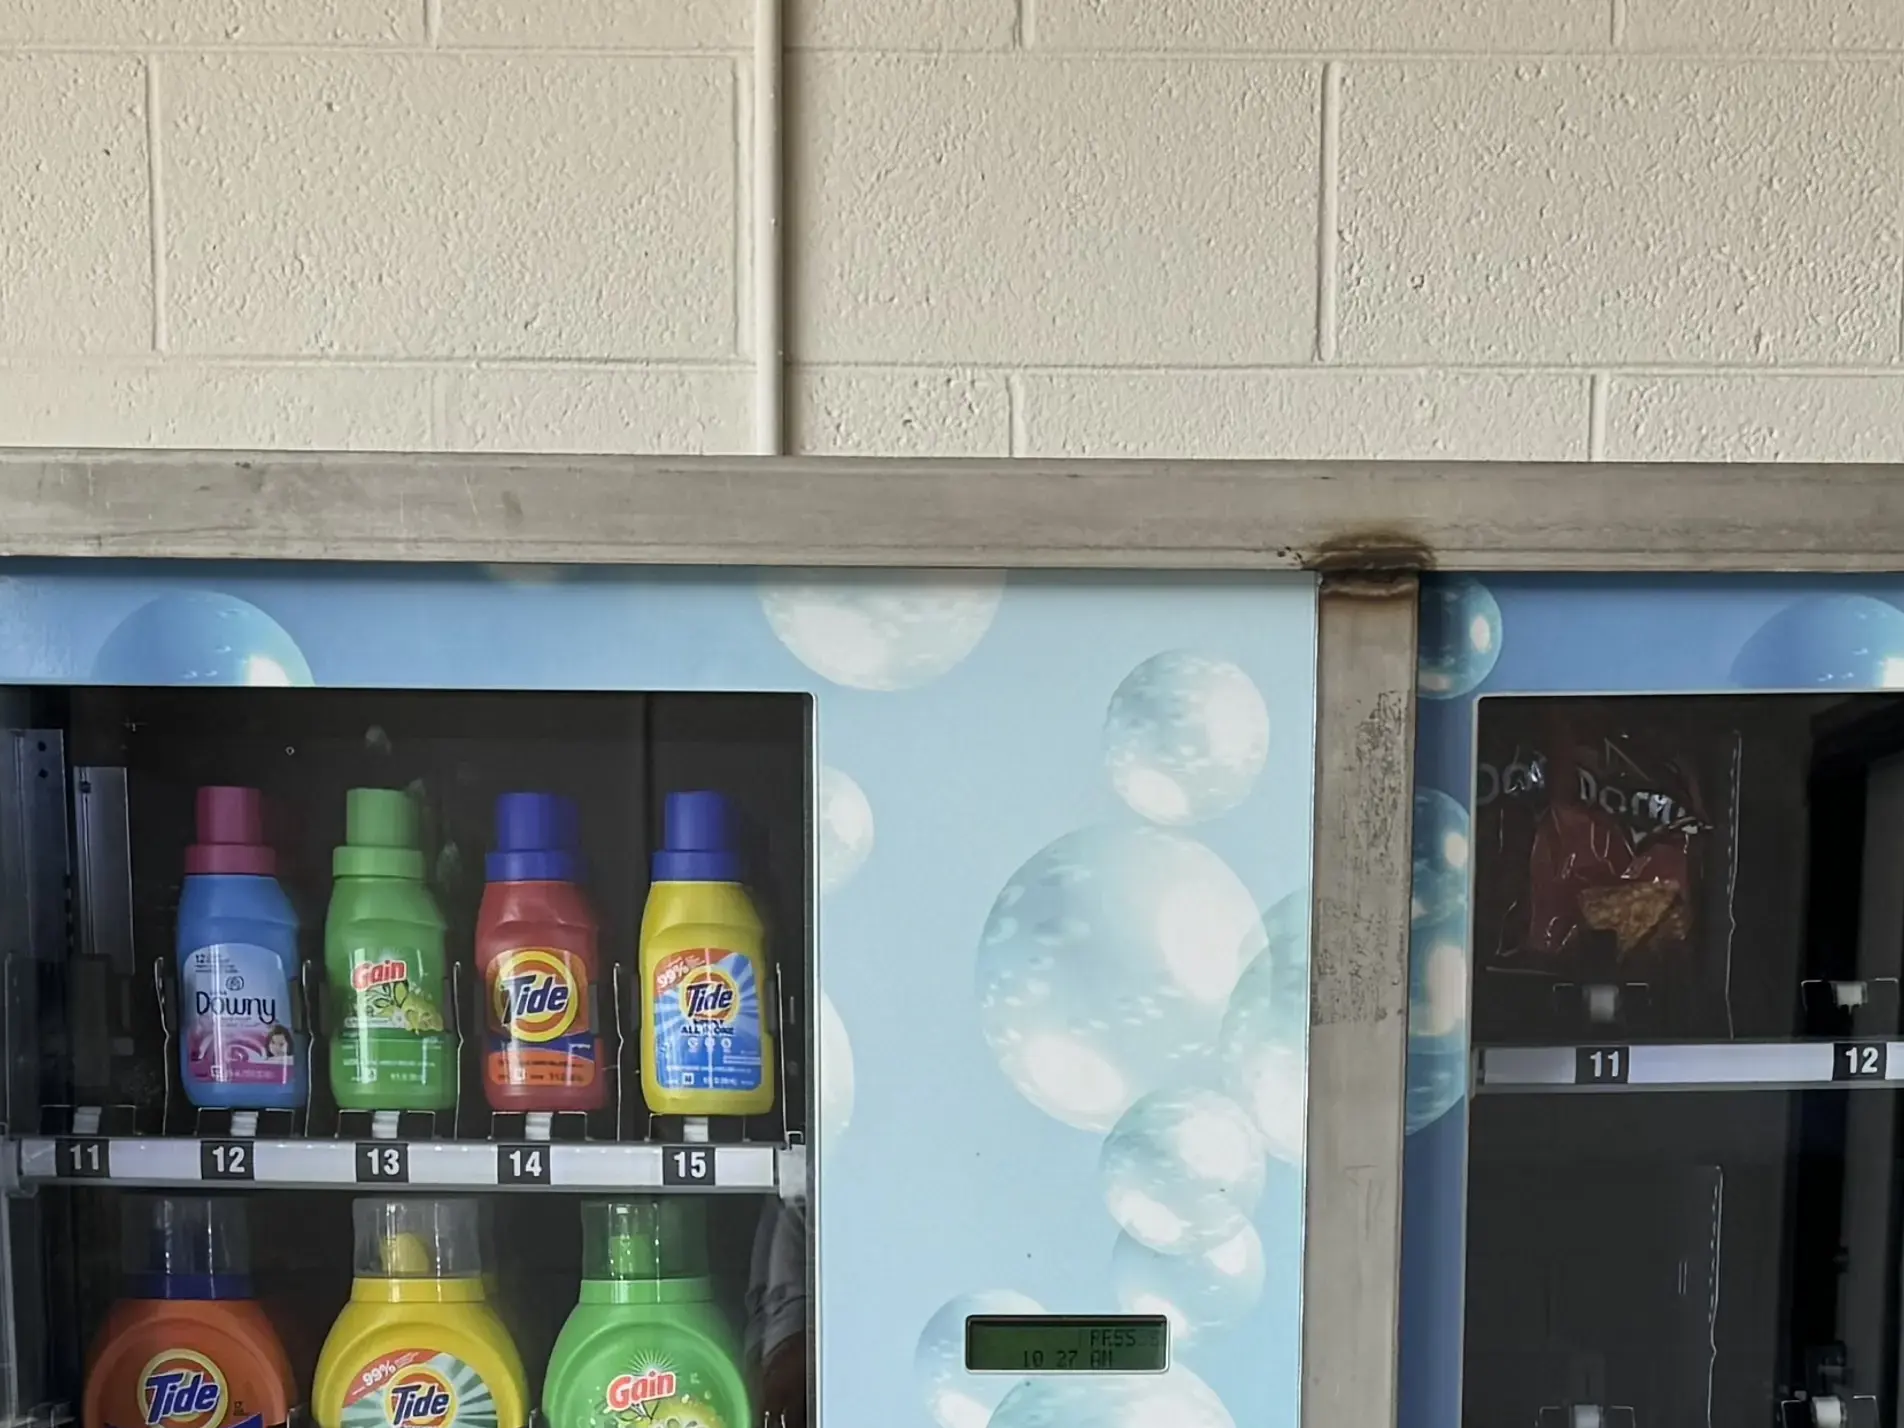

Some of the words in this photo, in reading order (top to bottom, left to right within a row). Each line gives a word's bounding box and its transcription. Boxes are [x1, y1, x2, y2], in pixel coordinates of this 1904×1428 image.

[352, 960, 406, 992] Gain
[196, 990, 276, 1025] Downy
[499, 973, 570, 1027] Tide
[684, 979, 734, 1018] Tide
[1590, 1050, 1619, 1077] 11
[1845, 1046, 1879, 1074] 12
[70, 1144, 100, 1171] 11
[212, 1146, 245, 1173] 12
[367, 1148, 400, 1175] 13
[509, 1150, 542, 1177] 14
[673, 1151, 707, 1178] 15
[144, 1370, 221, 1426] Tide
[390, 1383, 451, 1427] Tide
[608, 1370, 675, 1412] Gain
